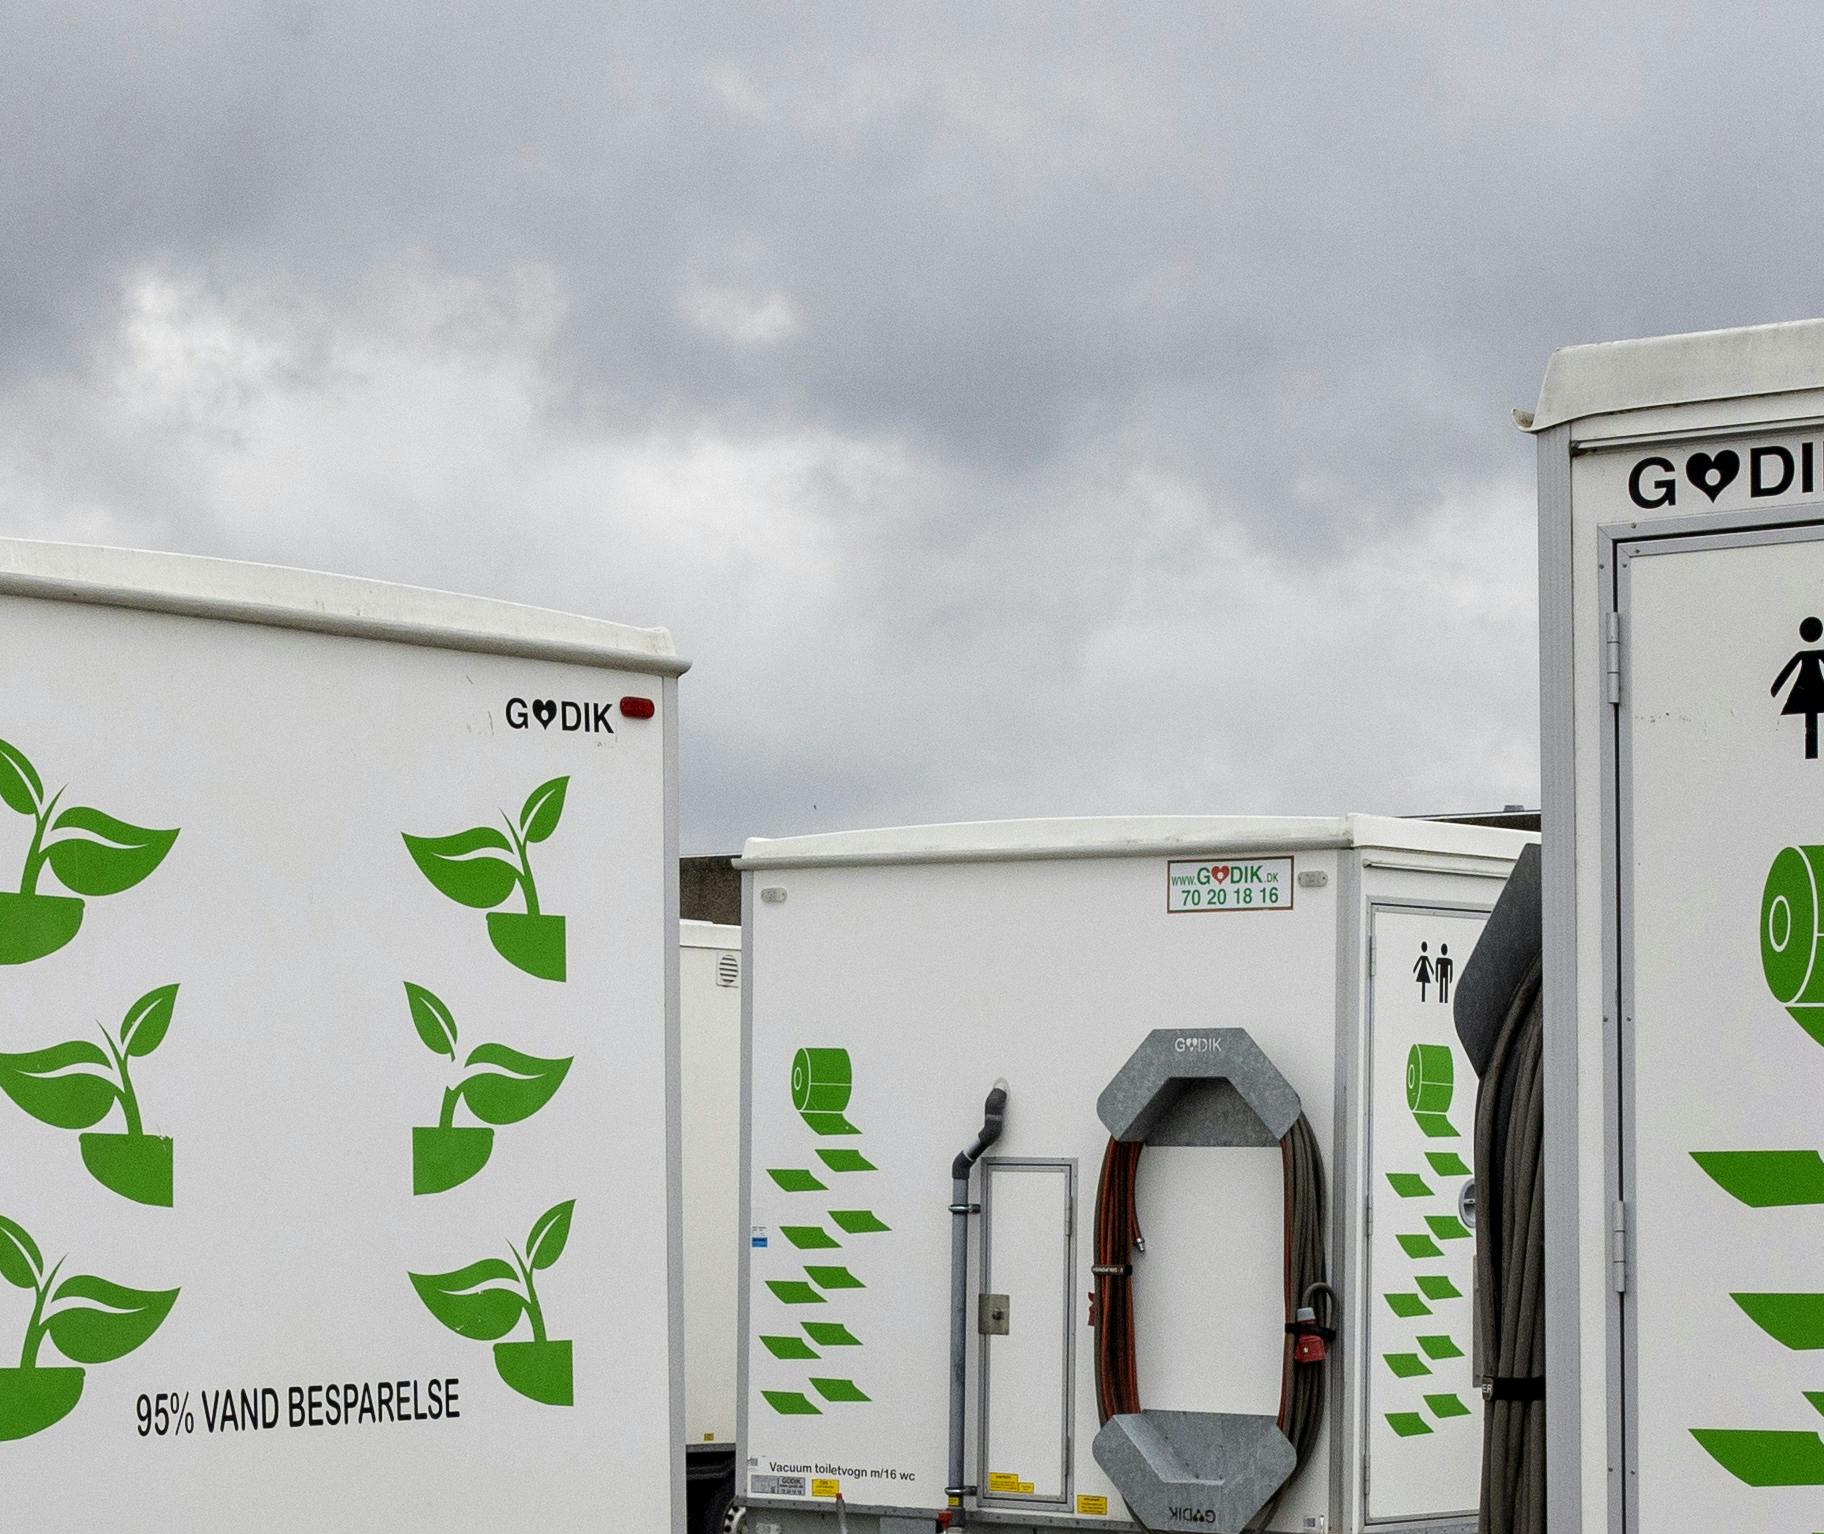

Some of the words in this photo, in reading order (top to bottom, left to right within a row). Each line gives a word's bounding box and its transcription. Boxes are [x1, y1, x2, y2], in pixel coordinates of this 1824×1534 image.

[1181, 889, 1201, 906] 70
[1207, 888, 1227, 905] 20
[1234, 887, 1253, 904] 18
[1259, 886, 1279, 904] 16
[136, 1391, 195, 1437] 95%
[201, 1387, 279, 1434] VAND
[288, 1377, 461, 1428] BESPARELSE
[769, 1461, 812, 1473] Vacuum
[815, 1463, 867, 1480] toiletvogn
[870, 1468, 897, 1480] m/16
[899, 1472, 916, 1481] wc
